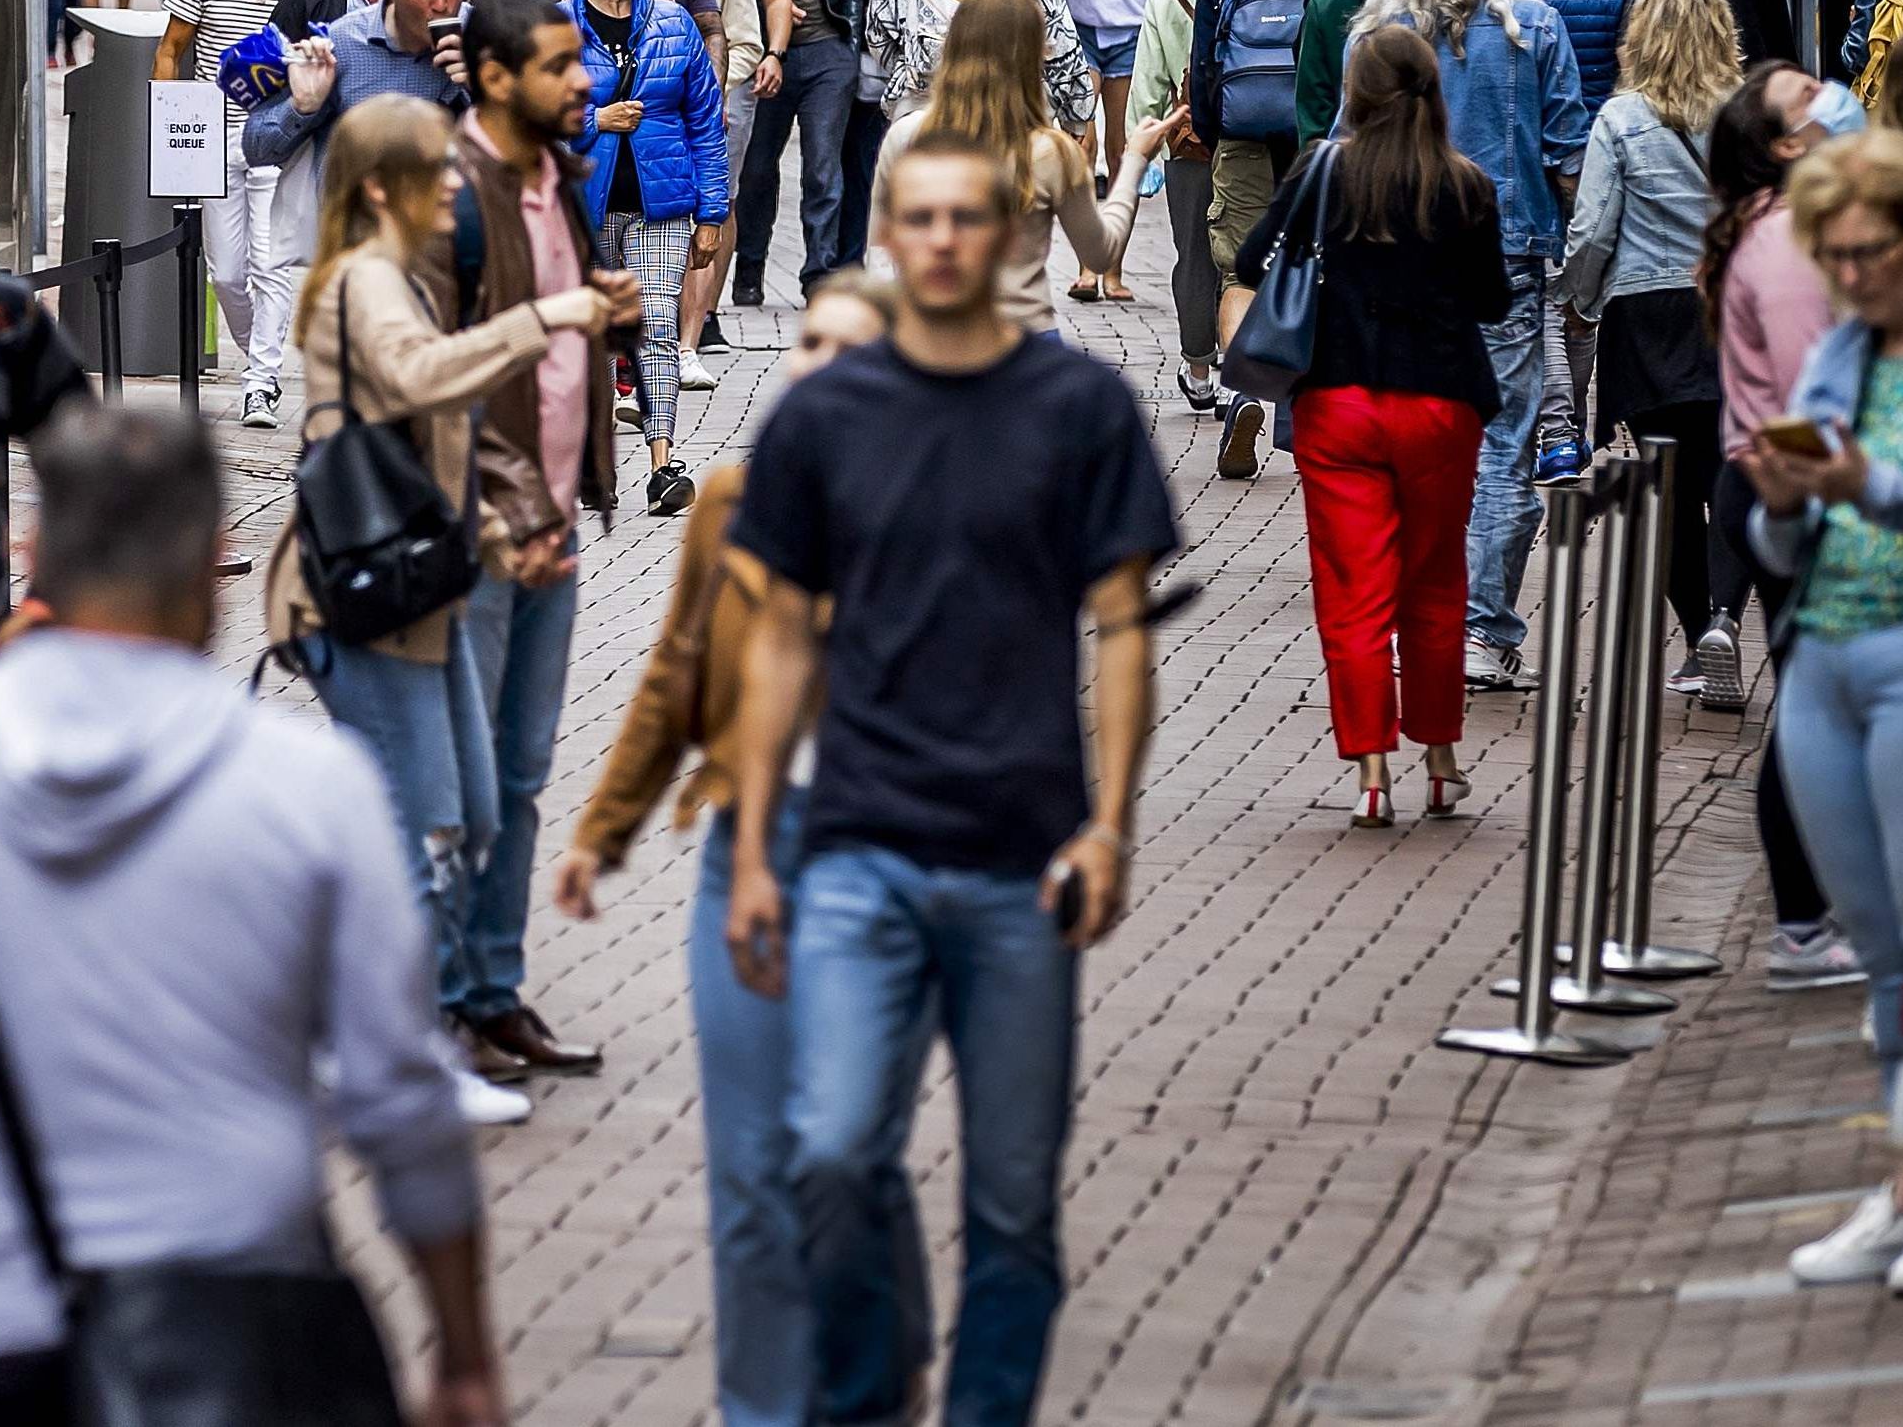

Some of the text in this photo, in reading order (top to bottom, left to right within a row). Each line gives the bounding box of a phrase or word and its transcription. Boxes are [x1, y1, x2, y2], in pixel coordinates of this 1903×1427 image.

[170, 124, 207, 133] END OF
[169, 138, 205, 148] QUEUE
